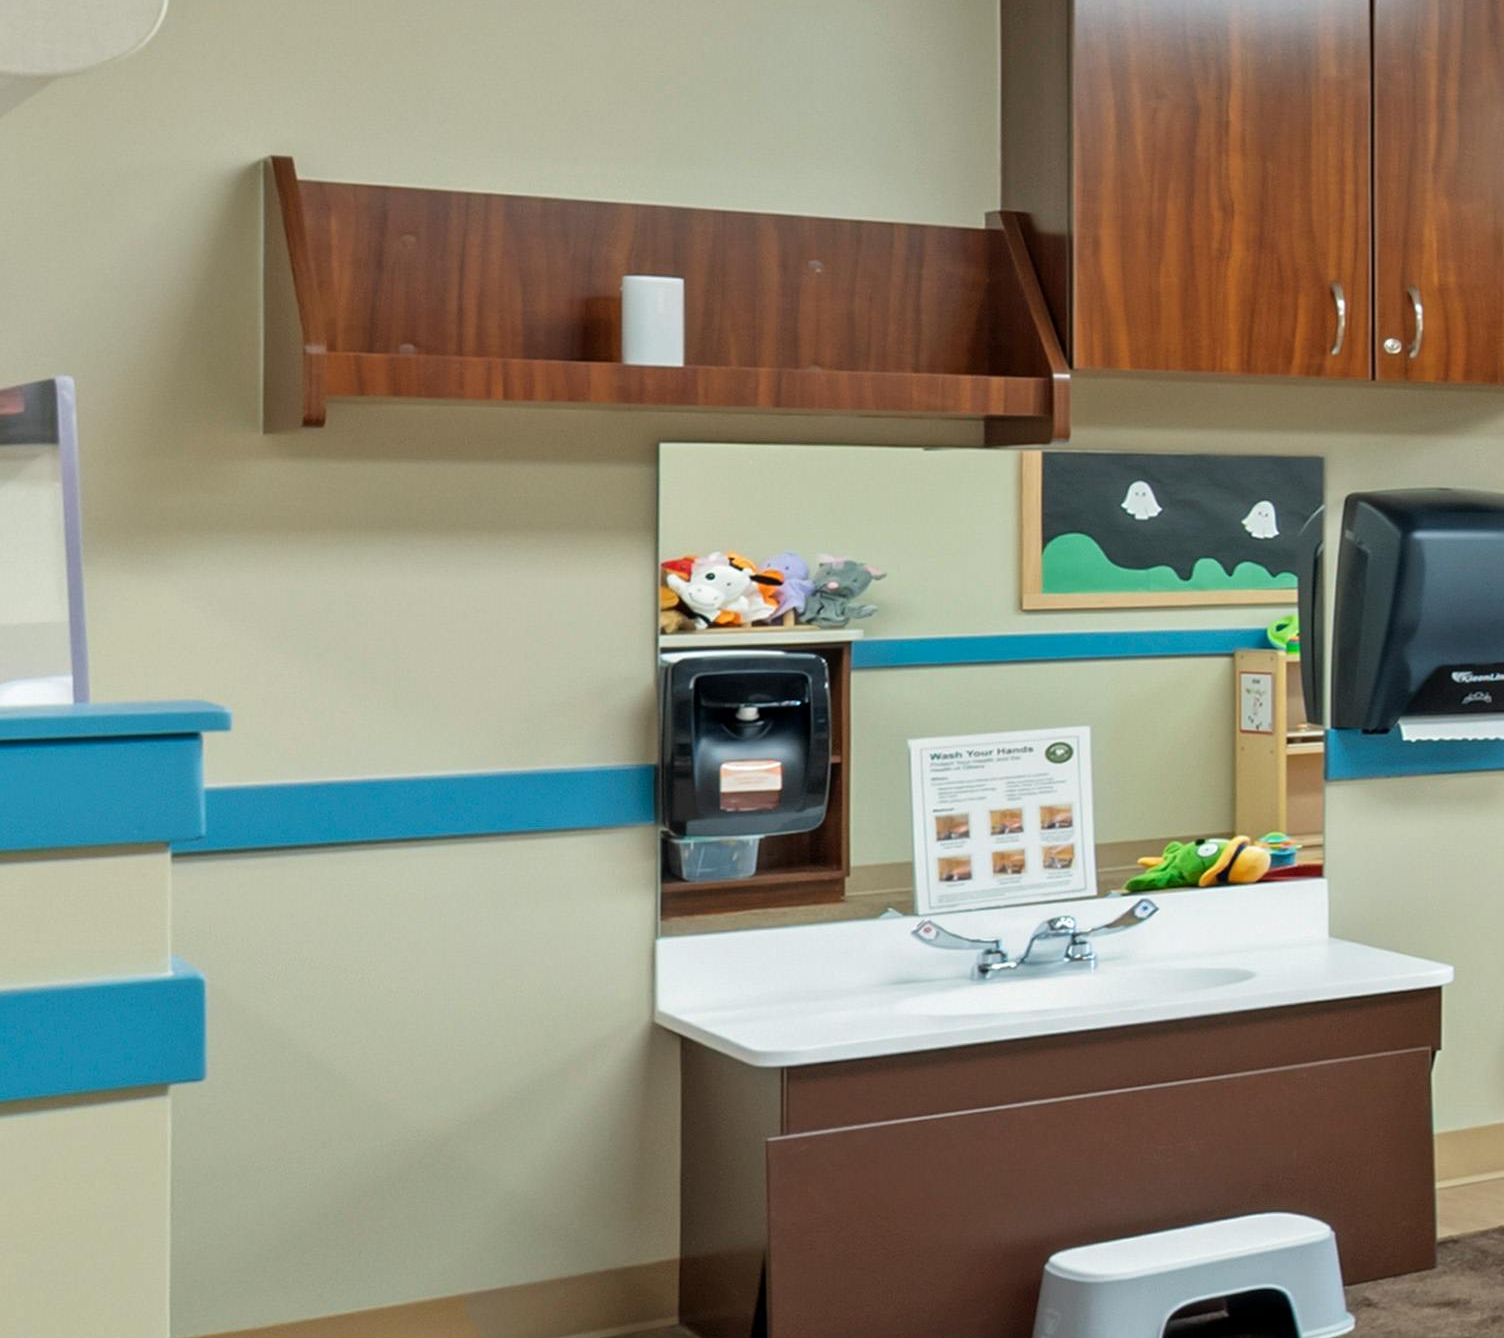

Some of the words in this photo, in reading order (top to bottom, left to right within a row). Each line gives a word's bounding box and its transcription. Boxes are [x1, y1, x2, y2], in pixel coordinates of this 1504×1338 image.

[930, 751, 963, 761] Wash
[966, 749, 993, 758] Your
[996, 745, 1034, 756] Hands
